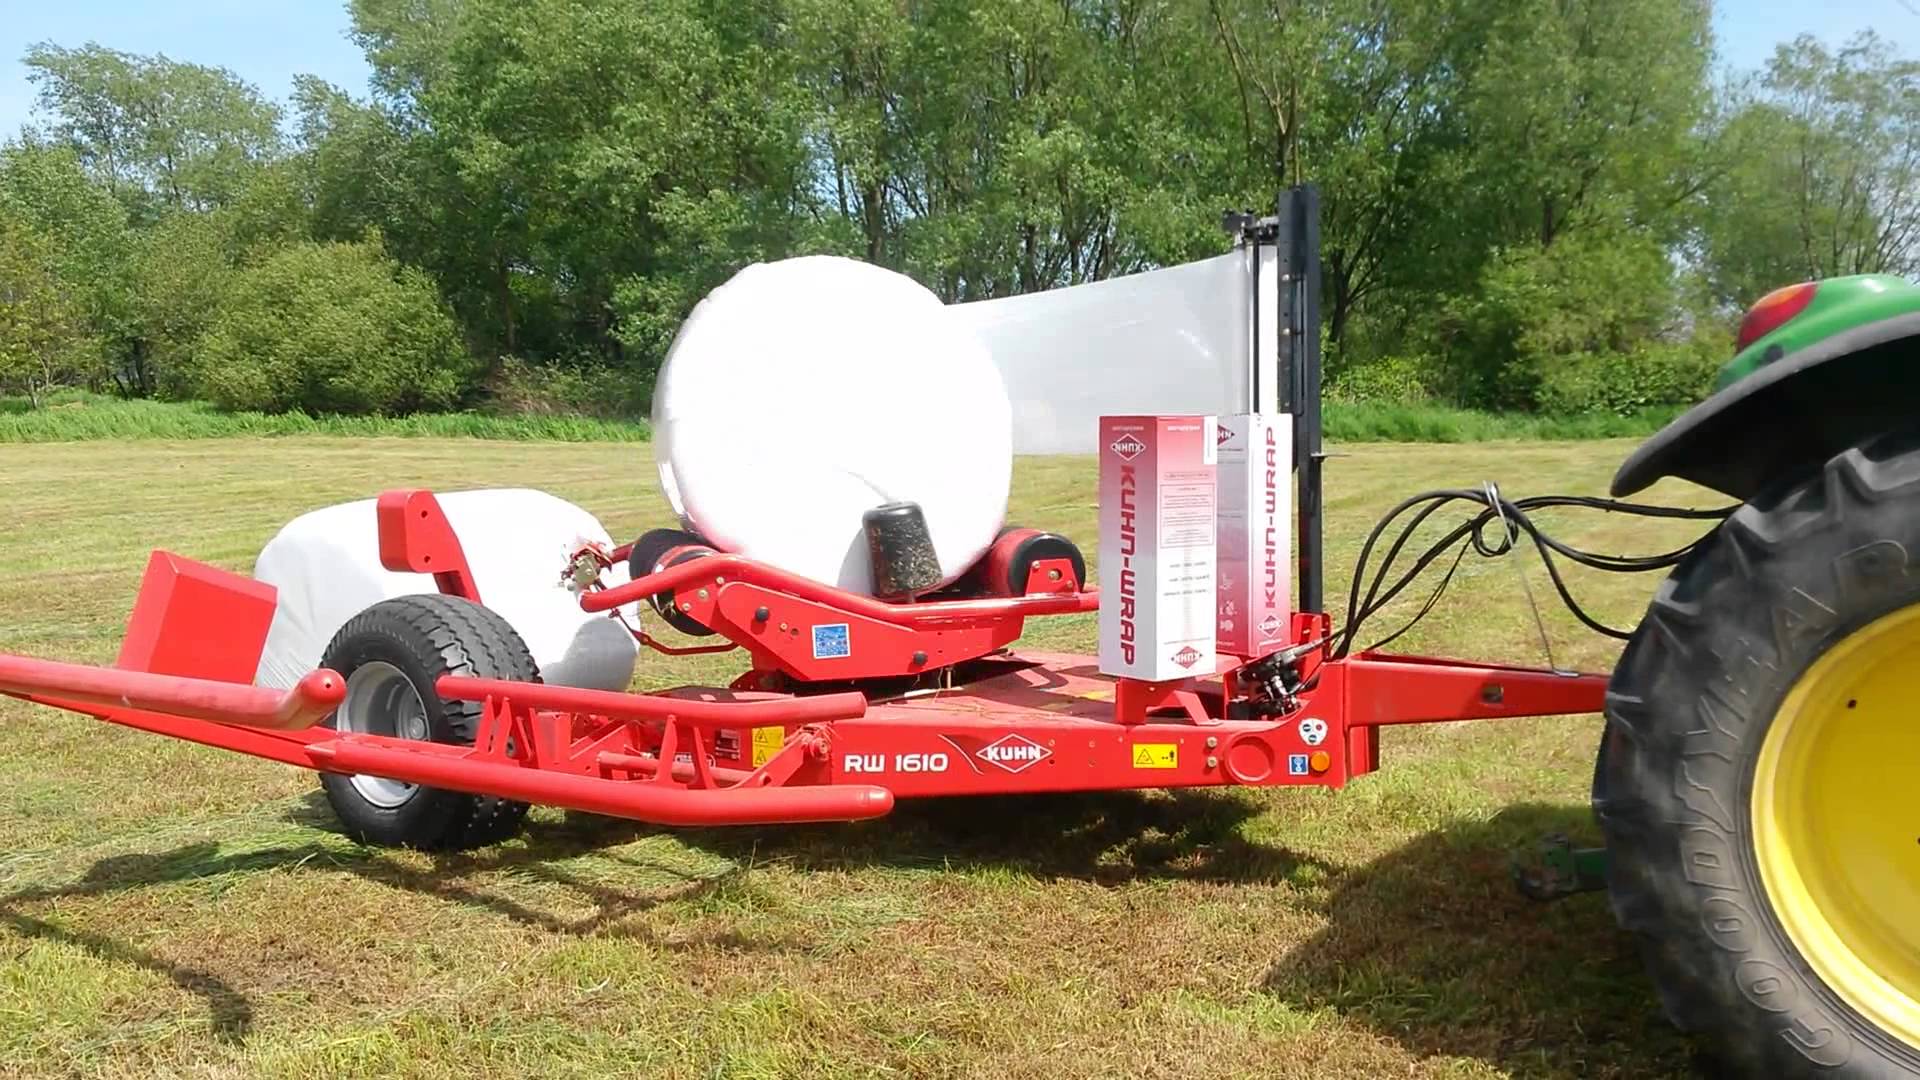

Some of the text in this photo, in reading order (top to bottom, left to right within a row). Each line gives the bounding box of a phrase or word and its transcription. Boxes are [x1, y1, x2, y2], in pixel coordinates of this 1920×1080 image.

[1115, 442, 1141, 453] KUHN
[1174, 651, 1199, 664] KUHN
[987, 745, 1041, 761] KUHN
[843, 753, 949, 773] RW 1610
